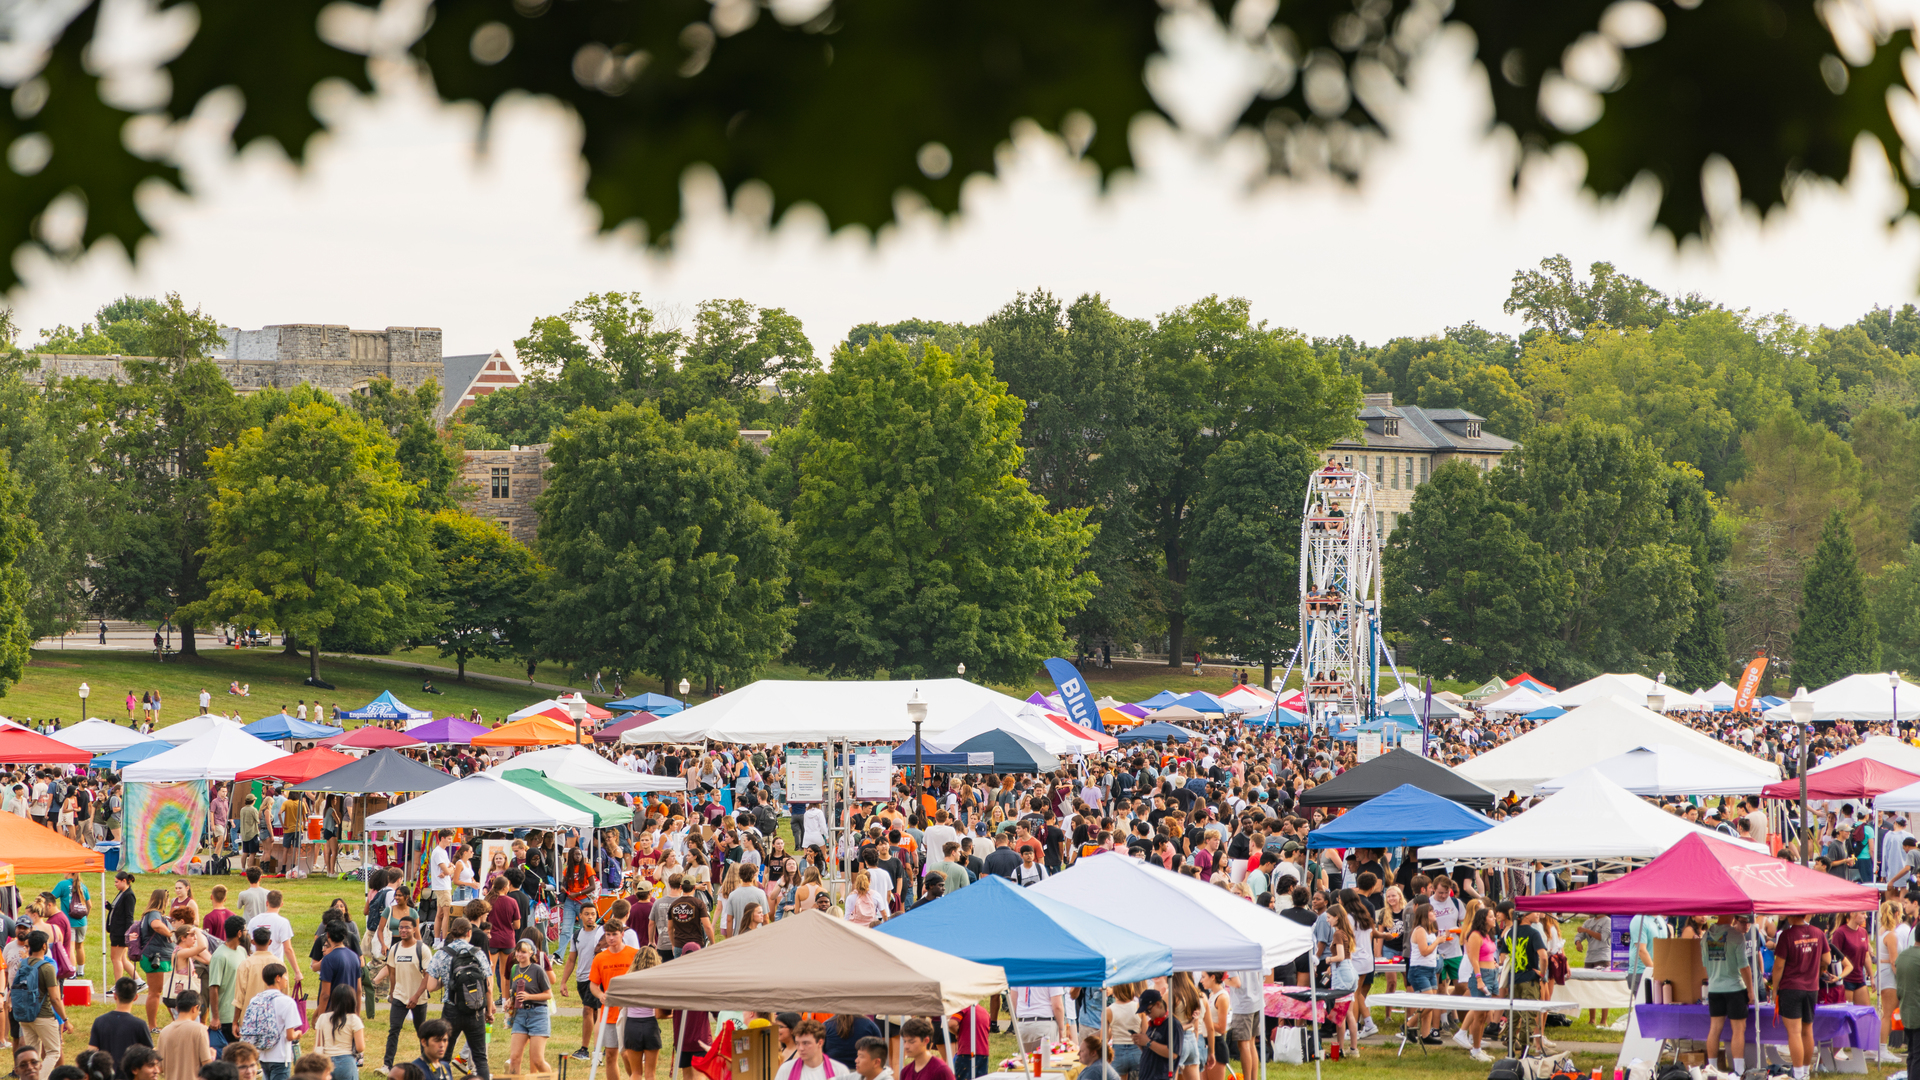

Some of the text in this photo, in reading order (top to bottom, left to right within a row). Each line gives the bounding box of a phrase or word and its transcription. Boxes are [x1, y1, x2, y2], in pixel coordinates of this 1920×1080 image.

[1060, 677, 1092, 729] Blue
[1738, 667, 1759, 708] Orange
[672, 906, 694, 915] Coors
